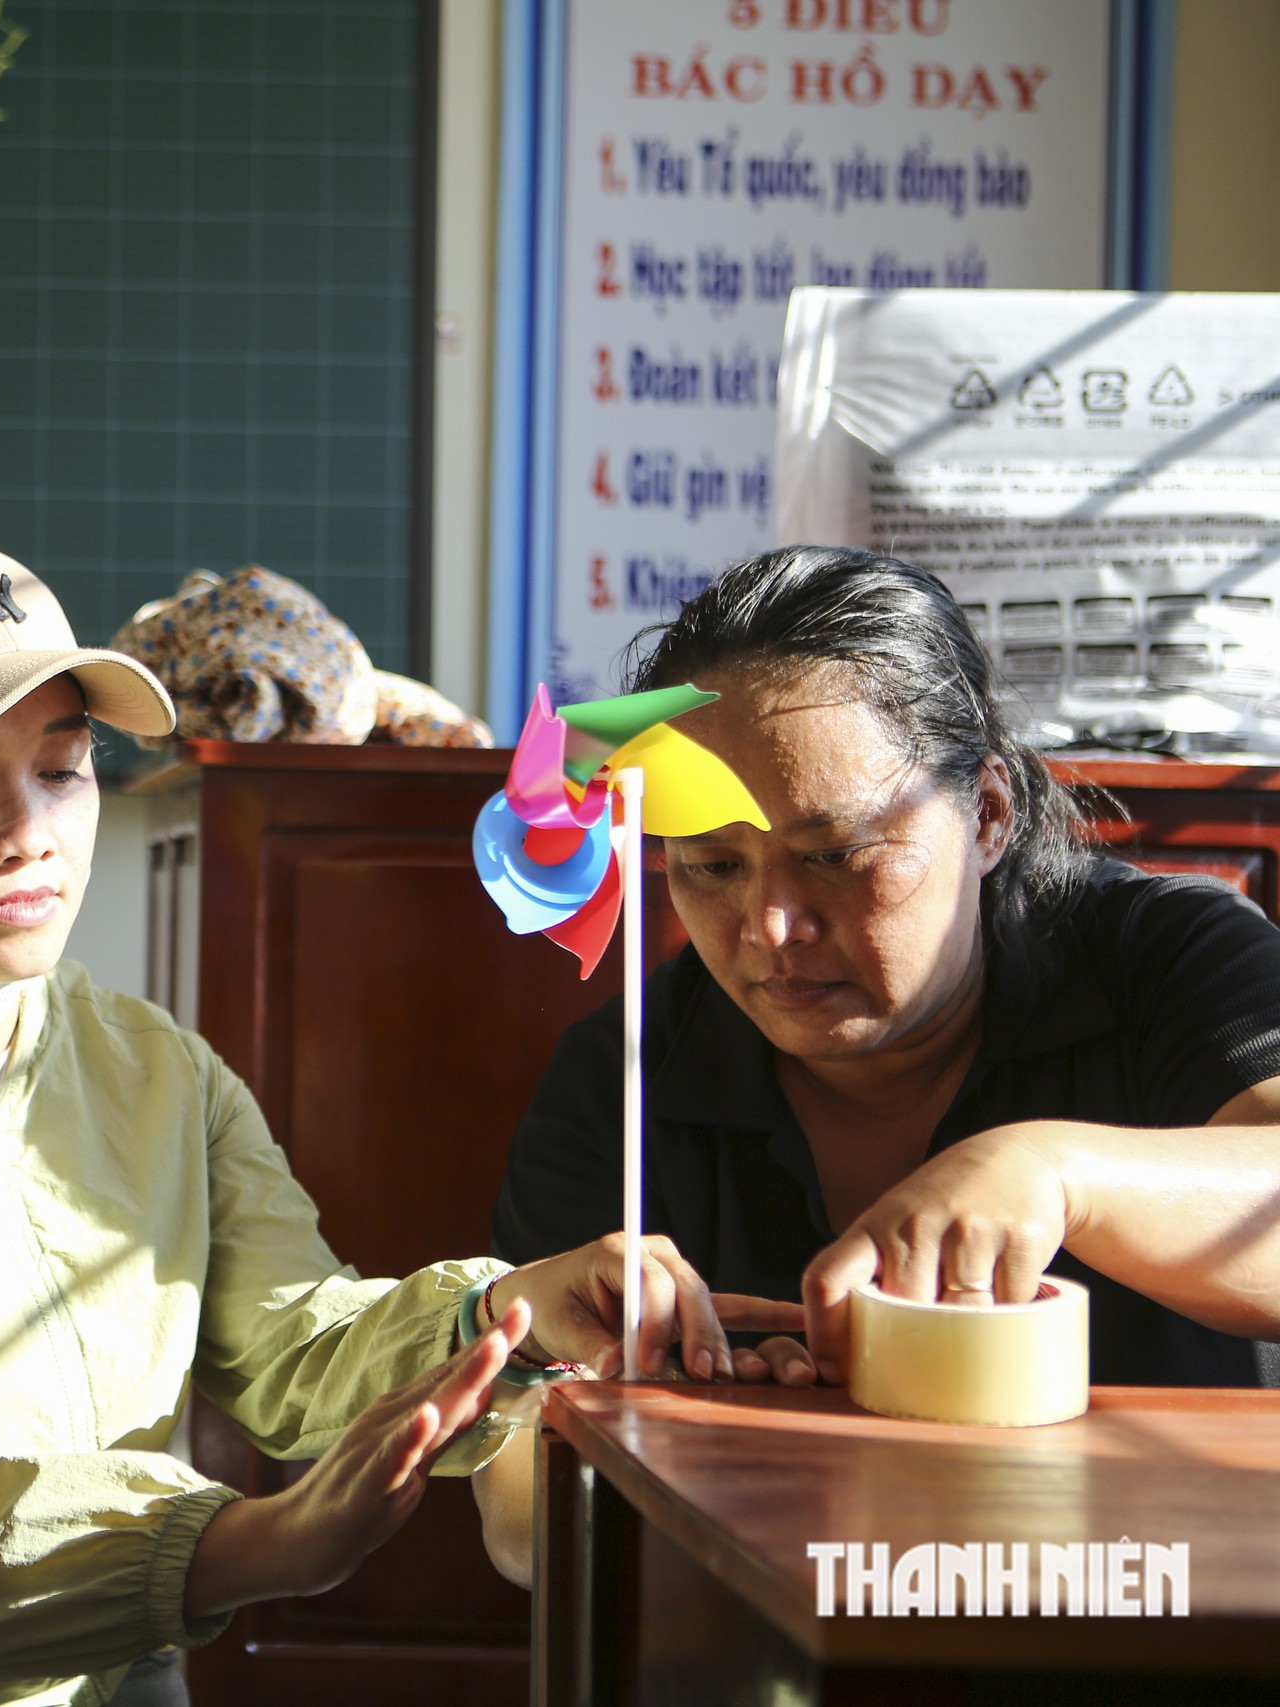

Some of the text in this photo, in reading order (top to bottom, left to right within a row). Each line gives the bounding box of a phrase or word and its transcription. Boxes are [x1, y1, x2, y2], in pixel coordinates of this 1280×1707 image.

[630, 40, 1050, 121] BÁC HỒ DẠY
[631, 136, 689, 196] Yêu
[833, 145, 886, 215] yêu
[630, 242, 687, 318] Học
[627, 346, 701, 405] Đoàn
[708, 337, 757, 406] kết
